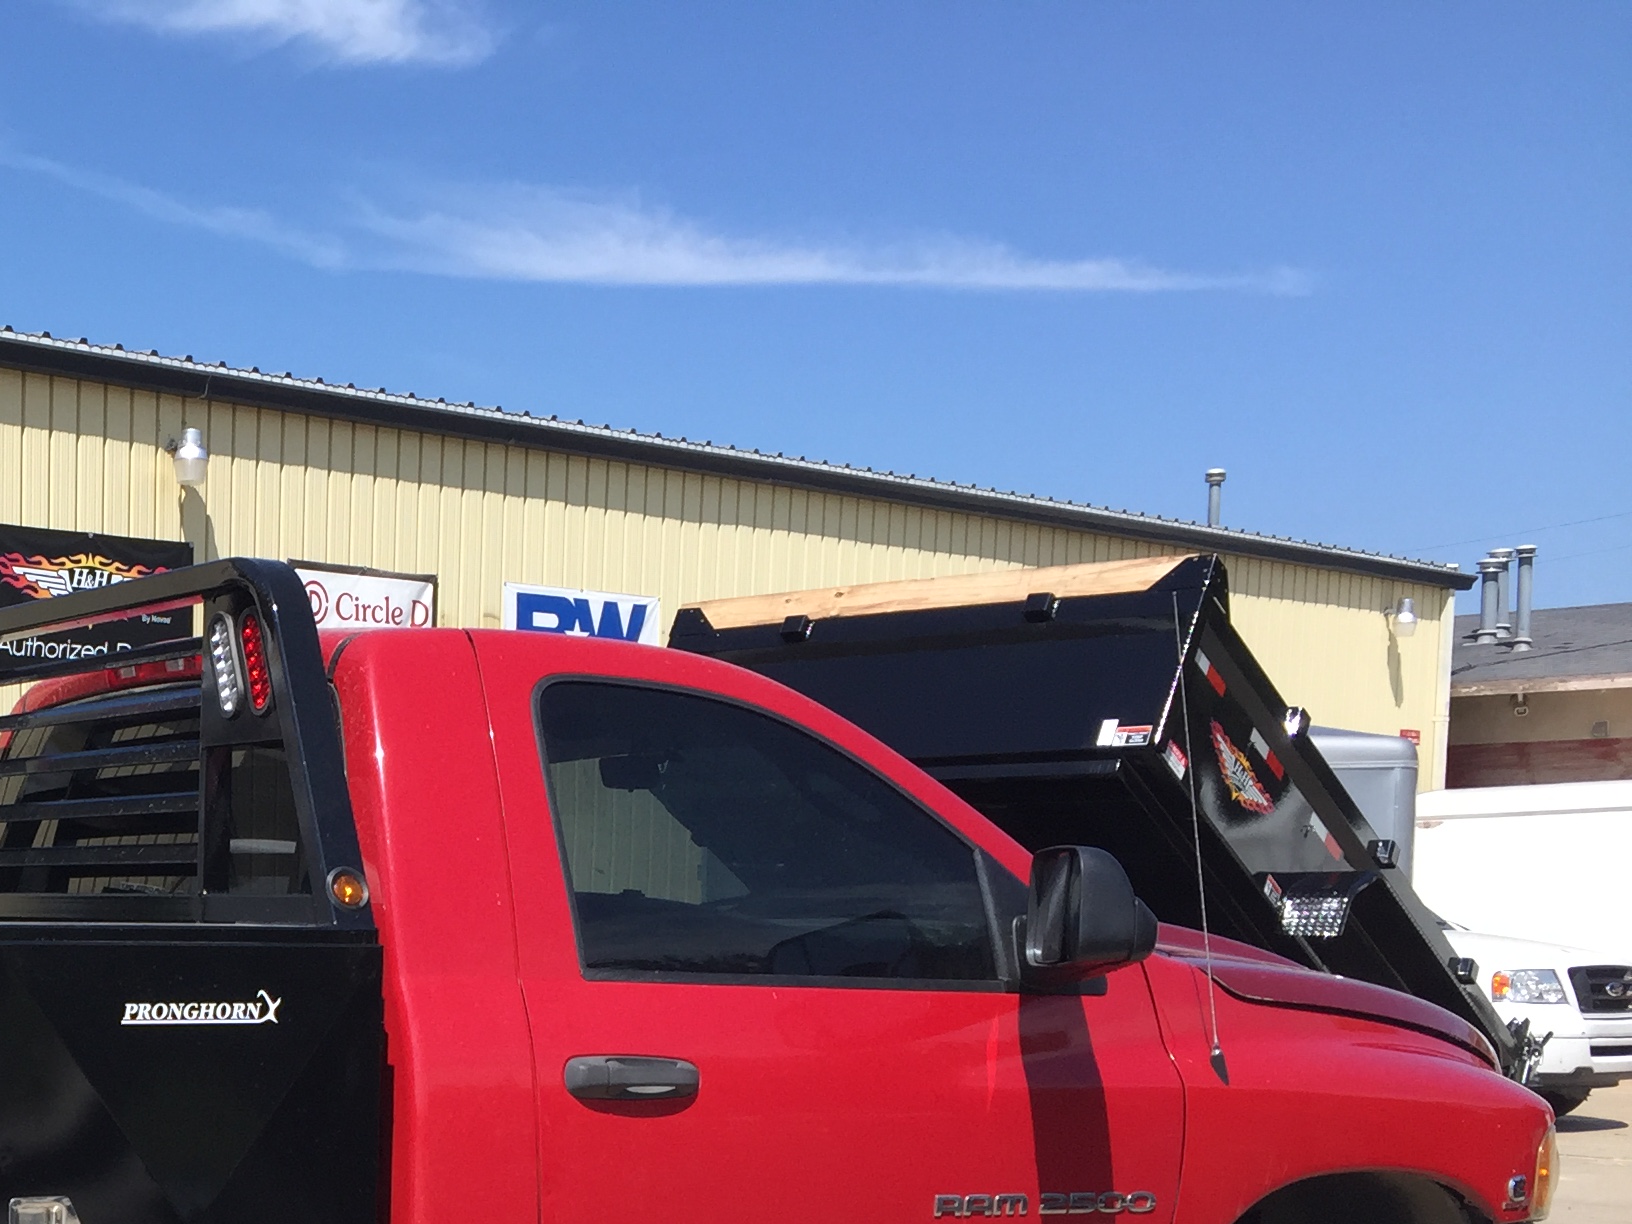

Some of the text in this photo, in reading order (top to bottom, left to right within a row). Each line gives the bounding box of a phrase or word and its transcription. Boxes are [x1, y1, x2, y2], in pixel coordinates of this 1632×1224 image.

[72, 568, 109, 588] H&H
[335, 592, 403, 626] Circle
[410, 600, 429, 627] D
[122, 1002, 262, 1020] PRONGHORN
[934, 1190, 1157, 1217] RAM 2500
